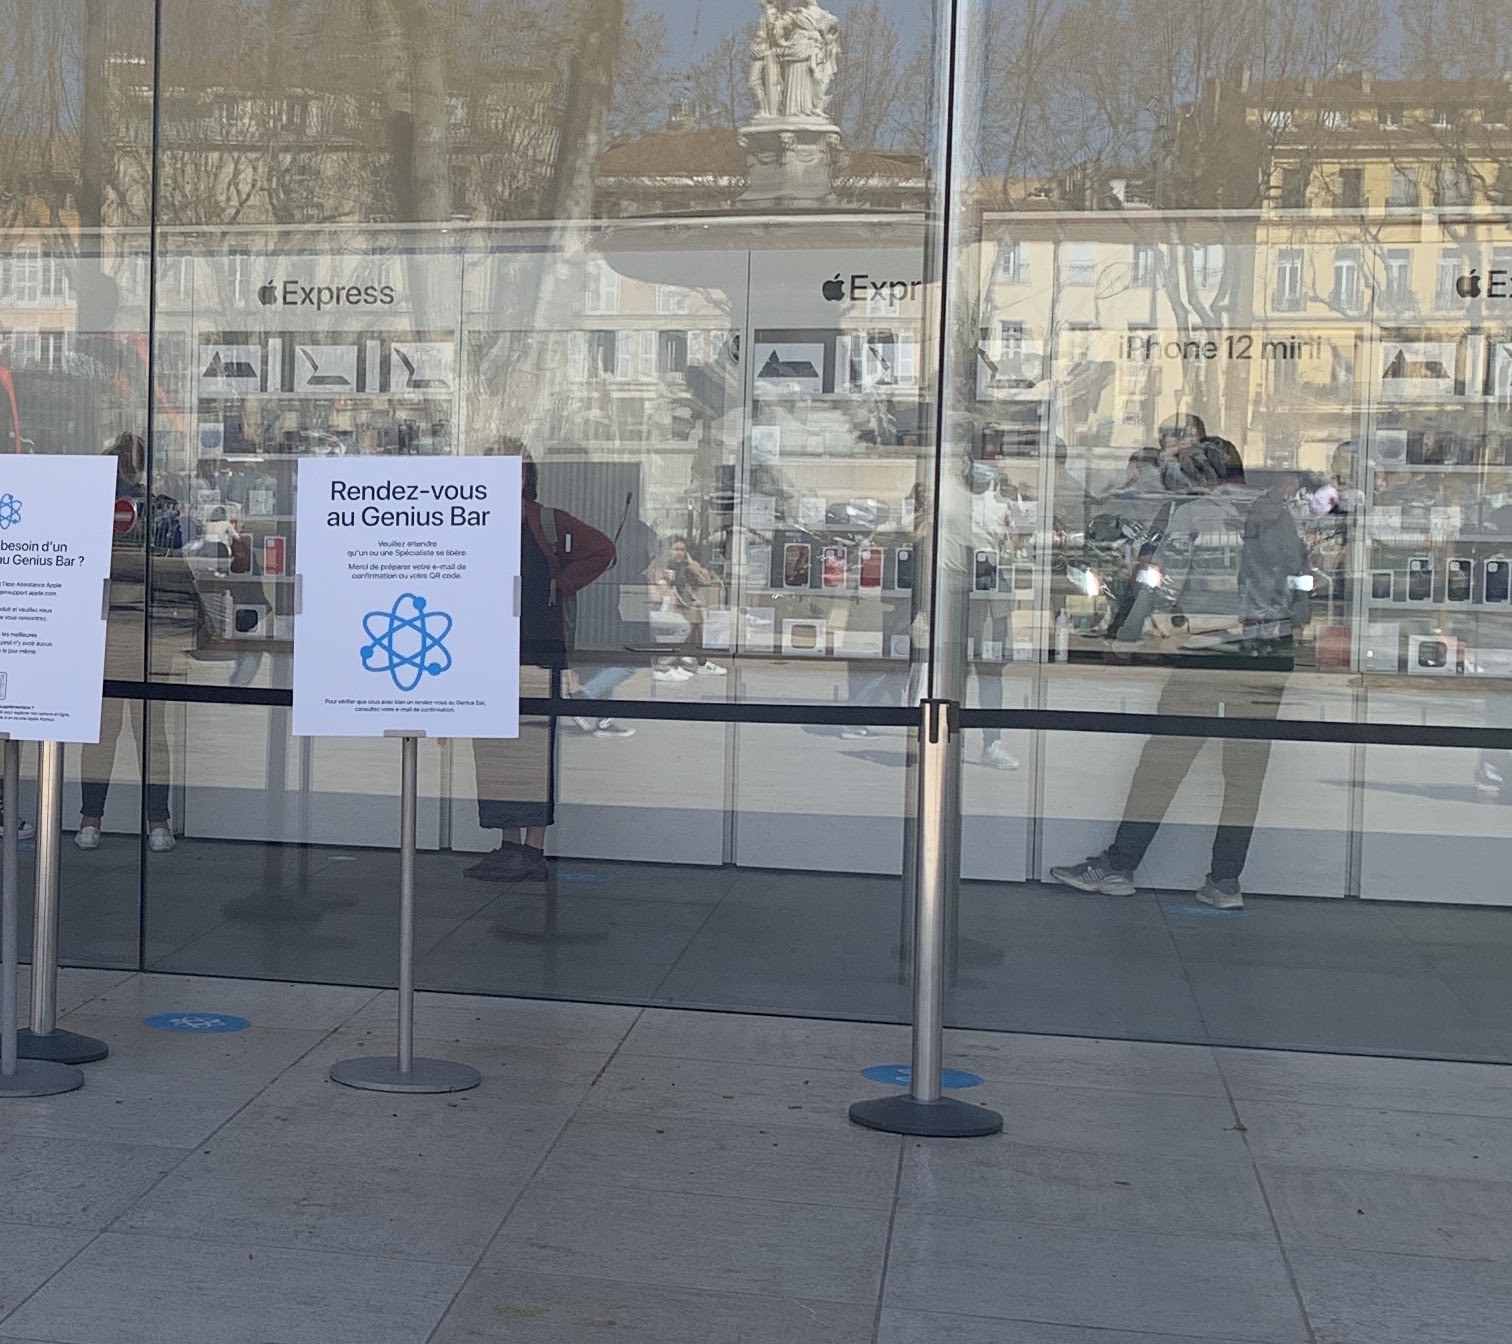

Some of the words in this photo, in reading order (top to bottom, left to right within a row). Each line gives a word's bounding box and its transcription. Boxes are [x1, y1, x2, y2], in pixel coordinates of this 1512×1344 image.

[282, 280, 394, 311] Express
[850, 275, 921, 307] Expr
[1119, 335, 1218, 359] iPhone
[1226, 335, 1253, 359] 12
[1262, 335, 1321, 359] mini
[331, 480, 487, 501] Rendez-vous
[327, 511, 355, 526] au
[362, 506, 444, 526] Genius
[450, 506, 490, 526] Bar
[1, 539, 38, 552] besoin
[13, 555, 53, 566] Genius
[55, 556, 76, 567] Bar
[78, 556, 84, 567] ?
